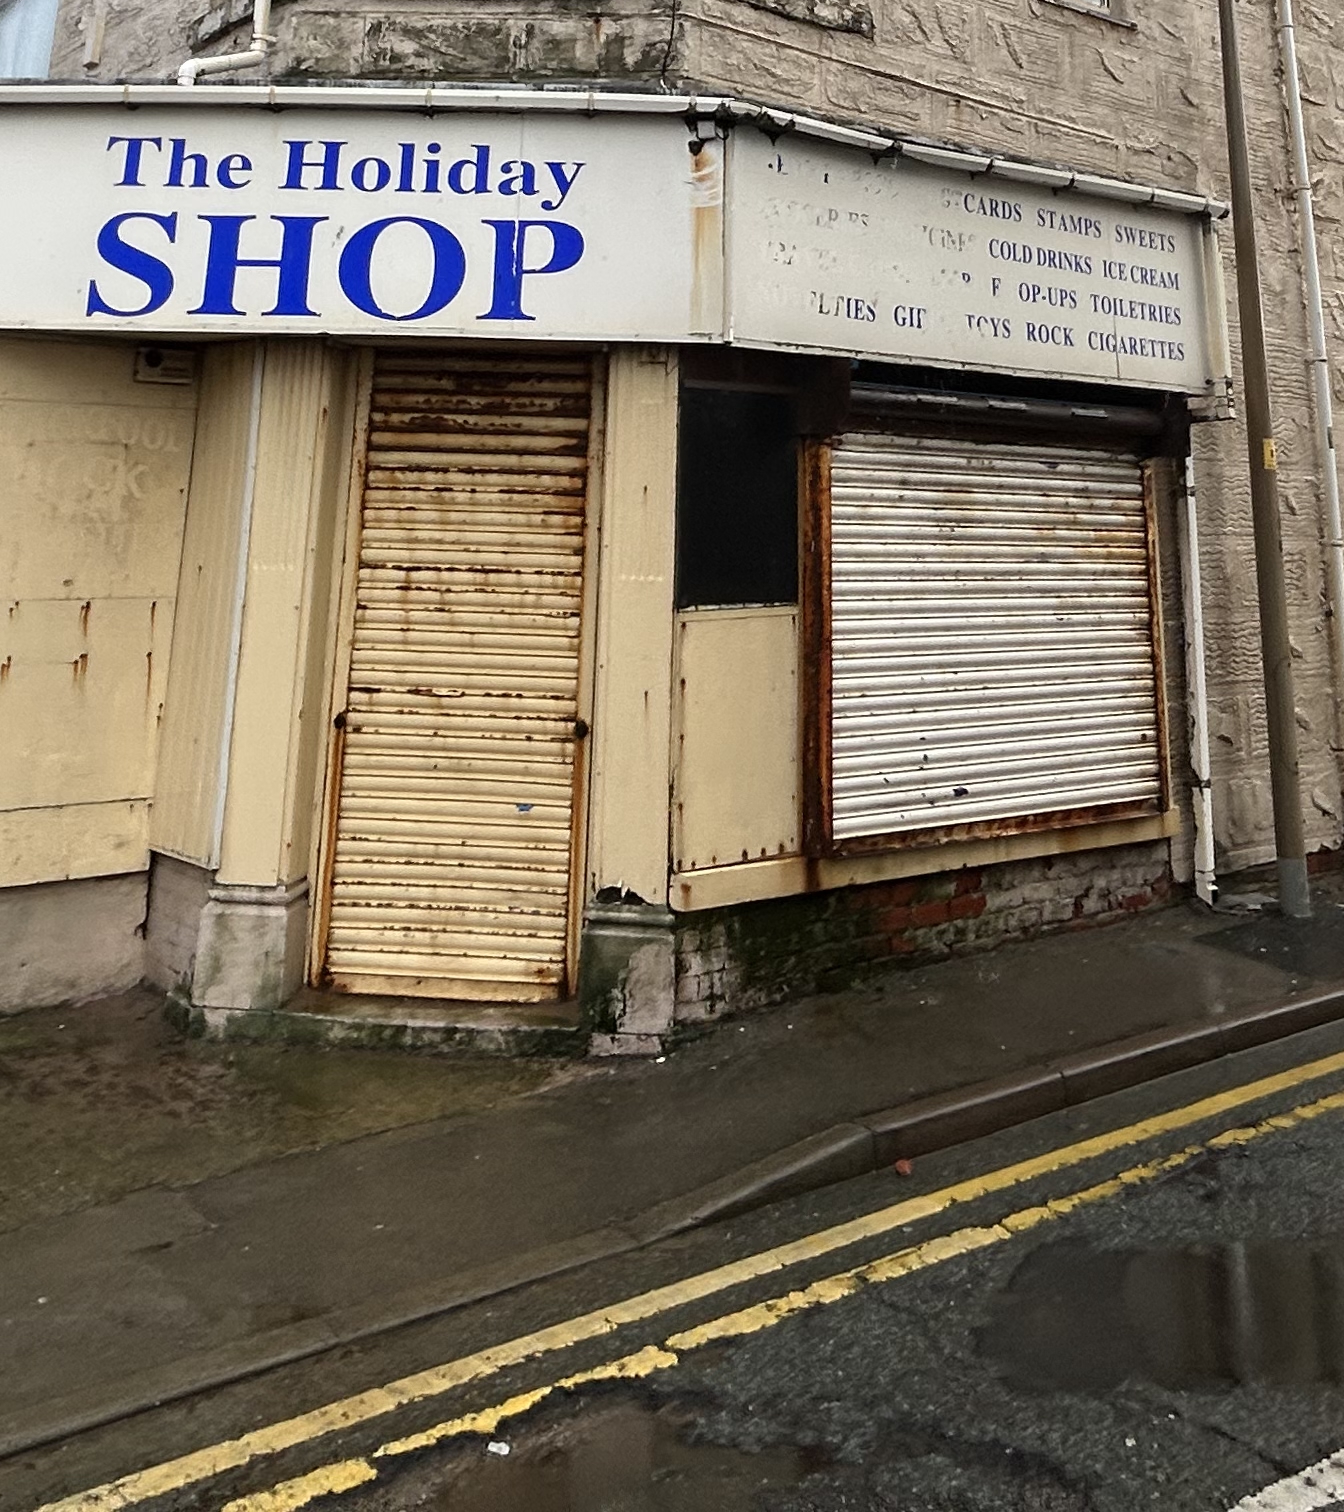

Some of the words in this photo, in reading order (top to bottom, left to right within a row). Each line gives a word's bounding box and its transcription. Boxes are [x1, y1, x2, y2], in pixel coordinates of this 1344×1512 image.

[107, 136, 253, 188] The
[279, 139, 586, 211] Holiday
[1037, 207, 1102, 238] STAMPS
[1115, 224, 1176, 253] SWEETS
[86, 211, 586, 321] SHOP
[989, 238, 1032, 264] COLD
[1037, 247, 1092, 275] DRINKS
[1103, 259, 1127, 282] ICE
[1131, 265, 1180, 290] CREAM
[1090, 293, 1182, 326] TOILETRIES
[1026, 322, 1074, 347] ROCK
[1088, 331, 1185, 362] CIGARETTES
